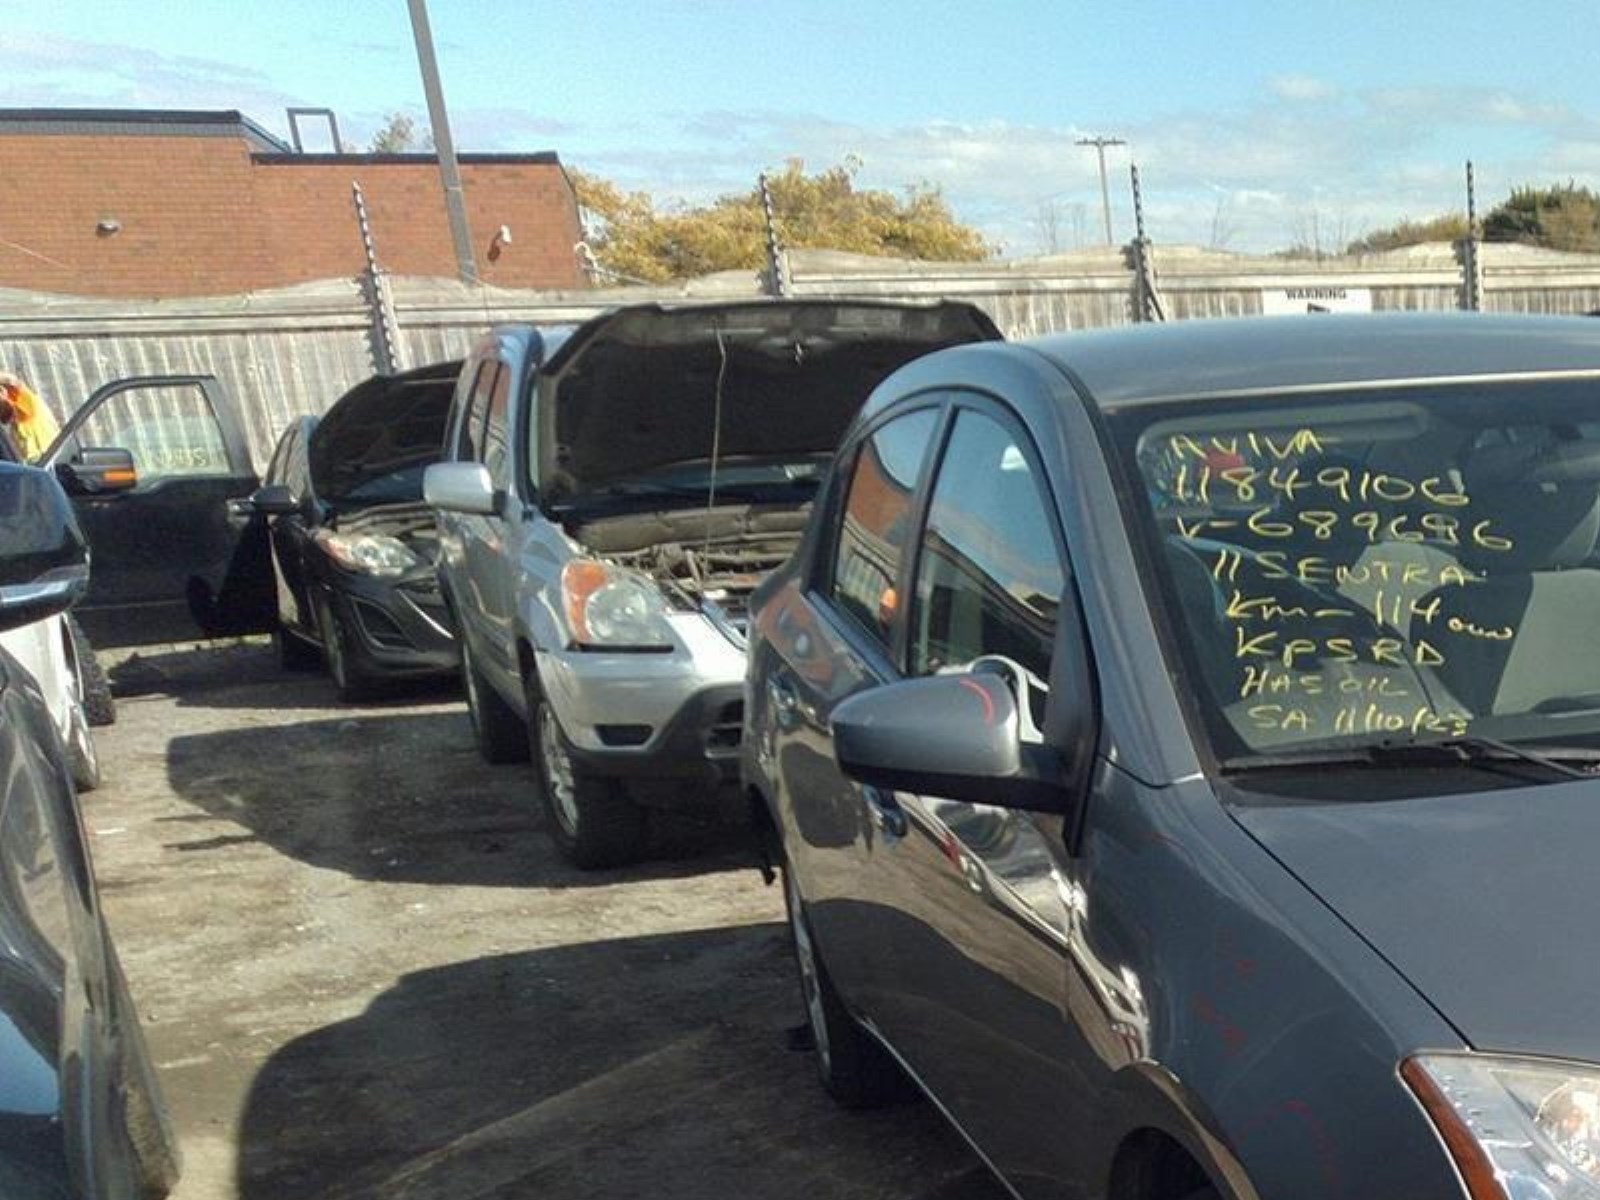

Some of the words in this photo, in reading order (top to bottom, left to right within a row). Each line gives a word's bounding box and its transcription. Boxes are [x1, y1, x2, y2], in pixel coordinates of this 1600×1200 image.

[1285, 287, 1347, 300] WARNING
[1171, 429, 1342, 459] AVIVA
[1177, 465, 1470, 505] 11849106
[1240, 666, 1323, 698] HAS
[1340, 677, 1409, 697] OIL
[1249, 704, 1308, 732] SA
